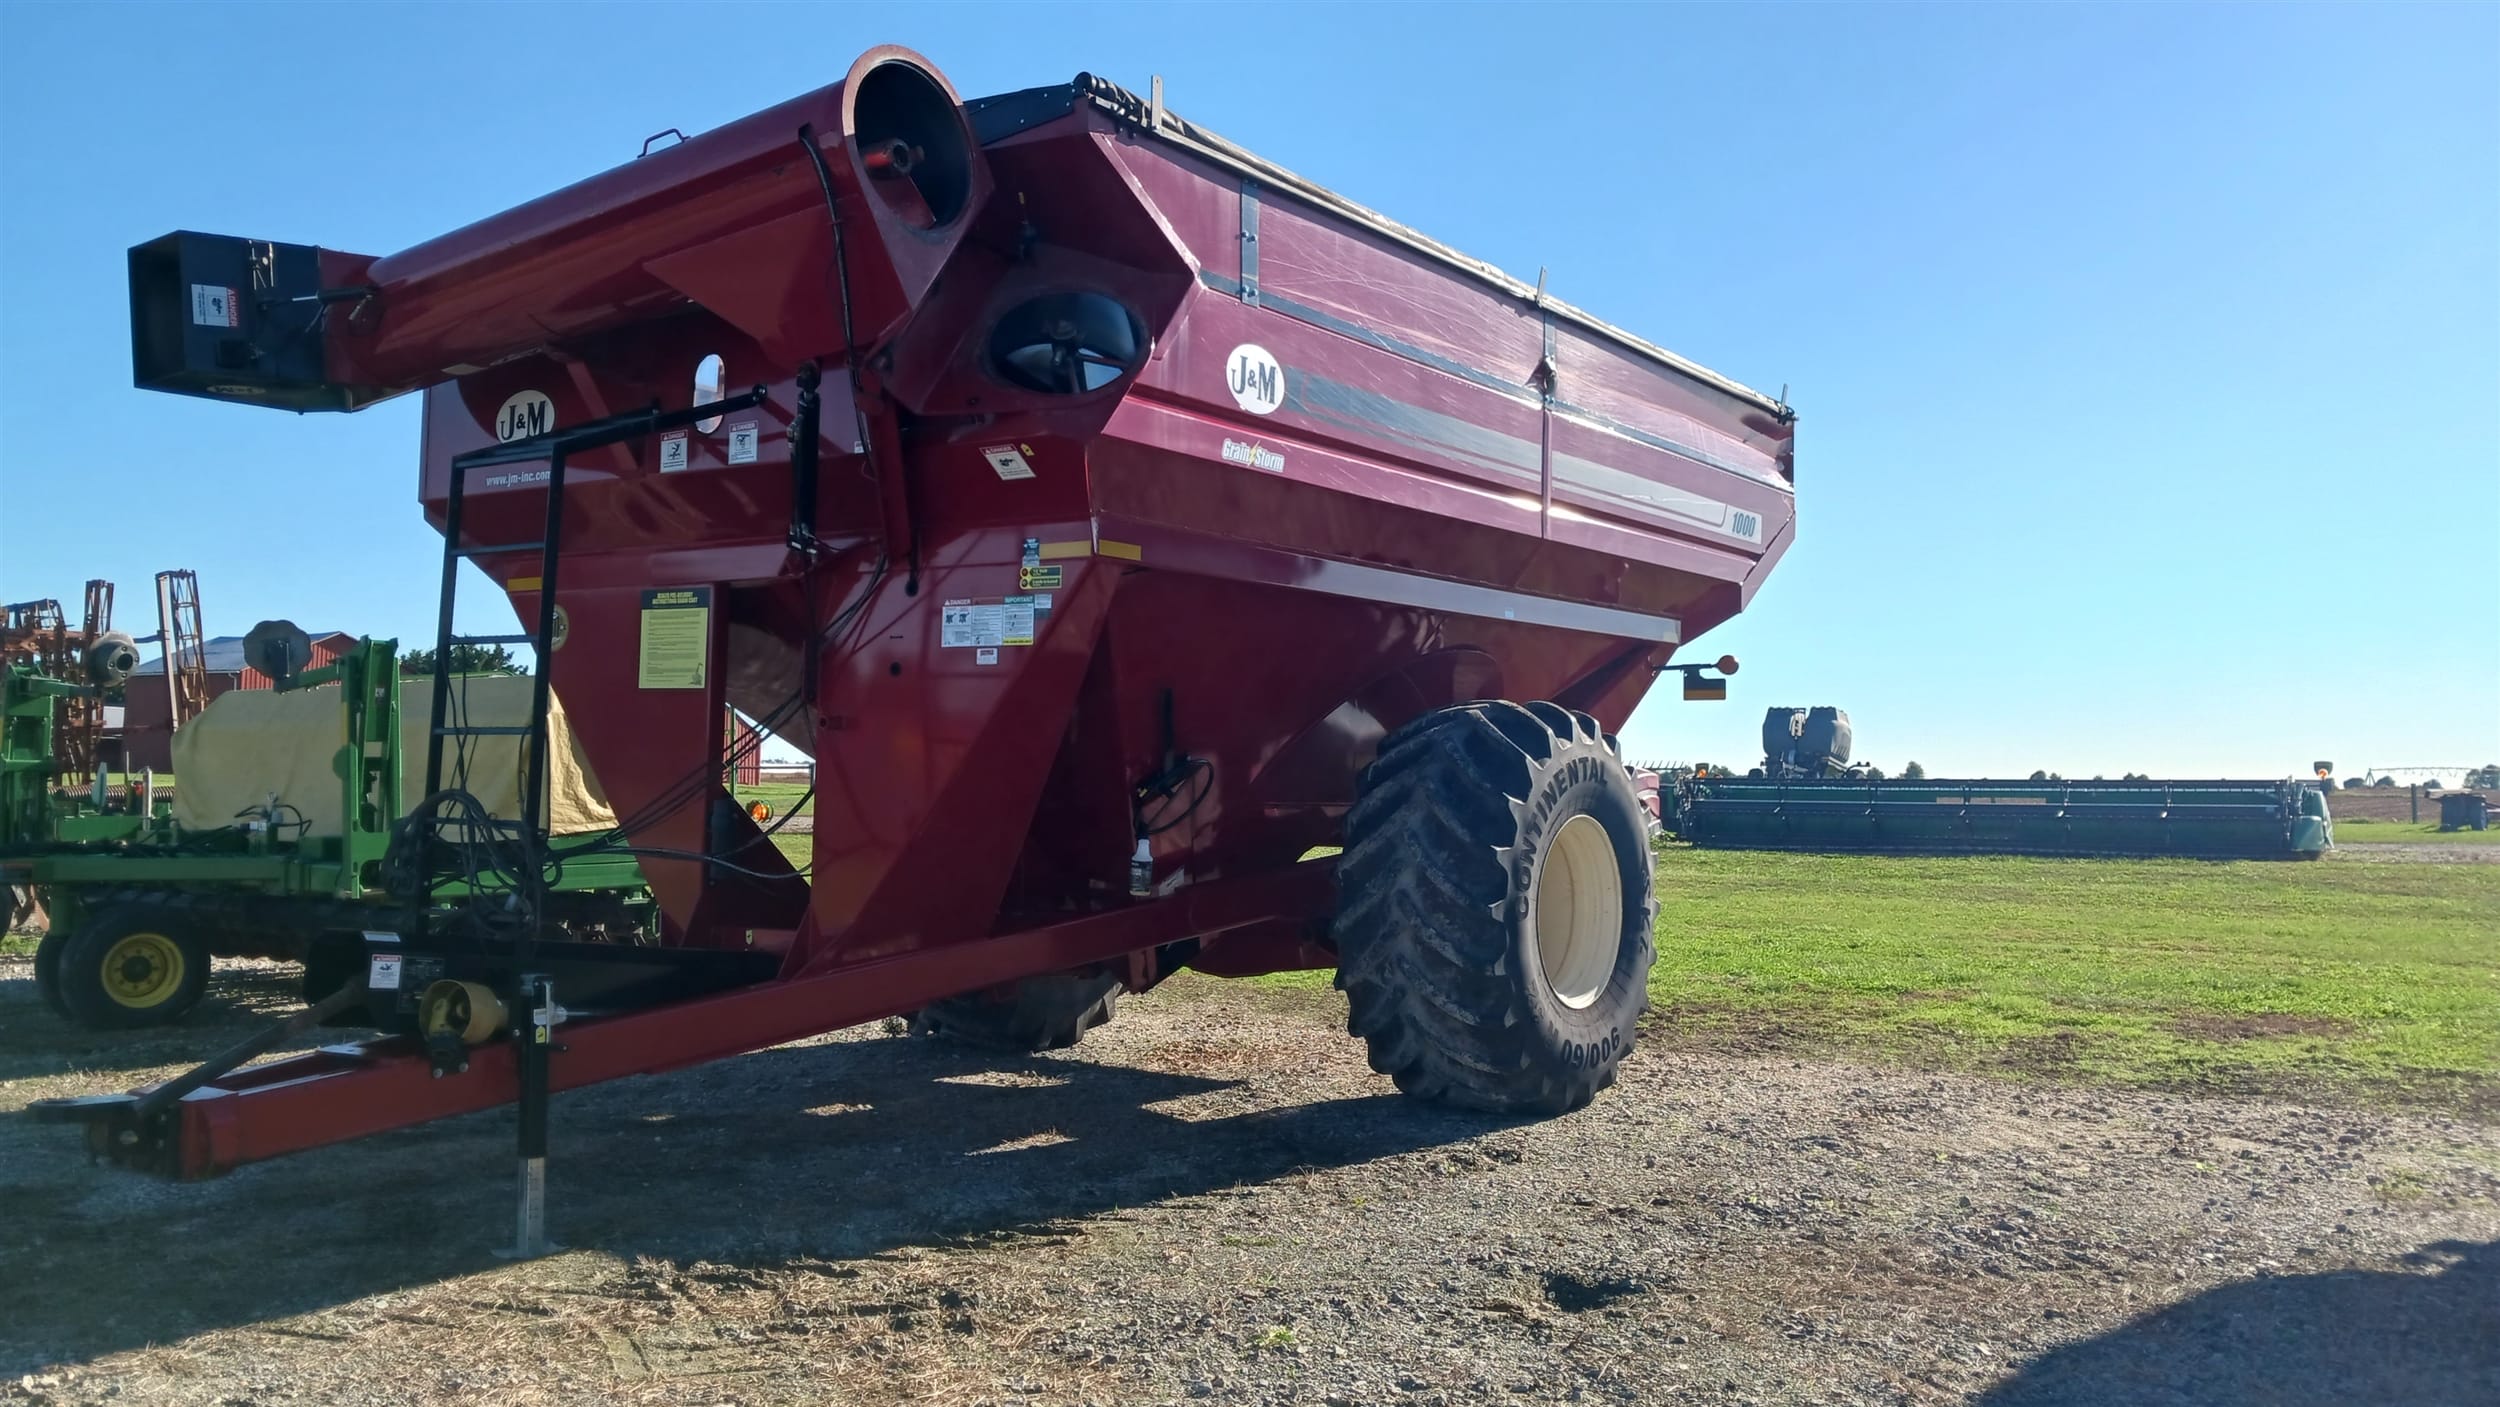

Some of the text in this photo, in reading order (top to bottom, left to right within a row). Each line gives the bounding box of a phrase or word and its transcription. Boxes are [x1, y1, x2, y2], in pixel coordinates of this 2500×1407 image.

[1231, 355, 1277, 405] J&M
[500, 400, 546, 440] J&M
[1222, 437, 1286, 473] Grain Storm
[1732, 511, 1757, 537] 1000
[1517, 756, 1609, 923] CONTINENTAL
[1562, 1026, 1620, 1072] 900/60
